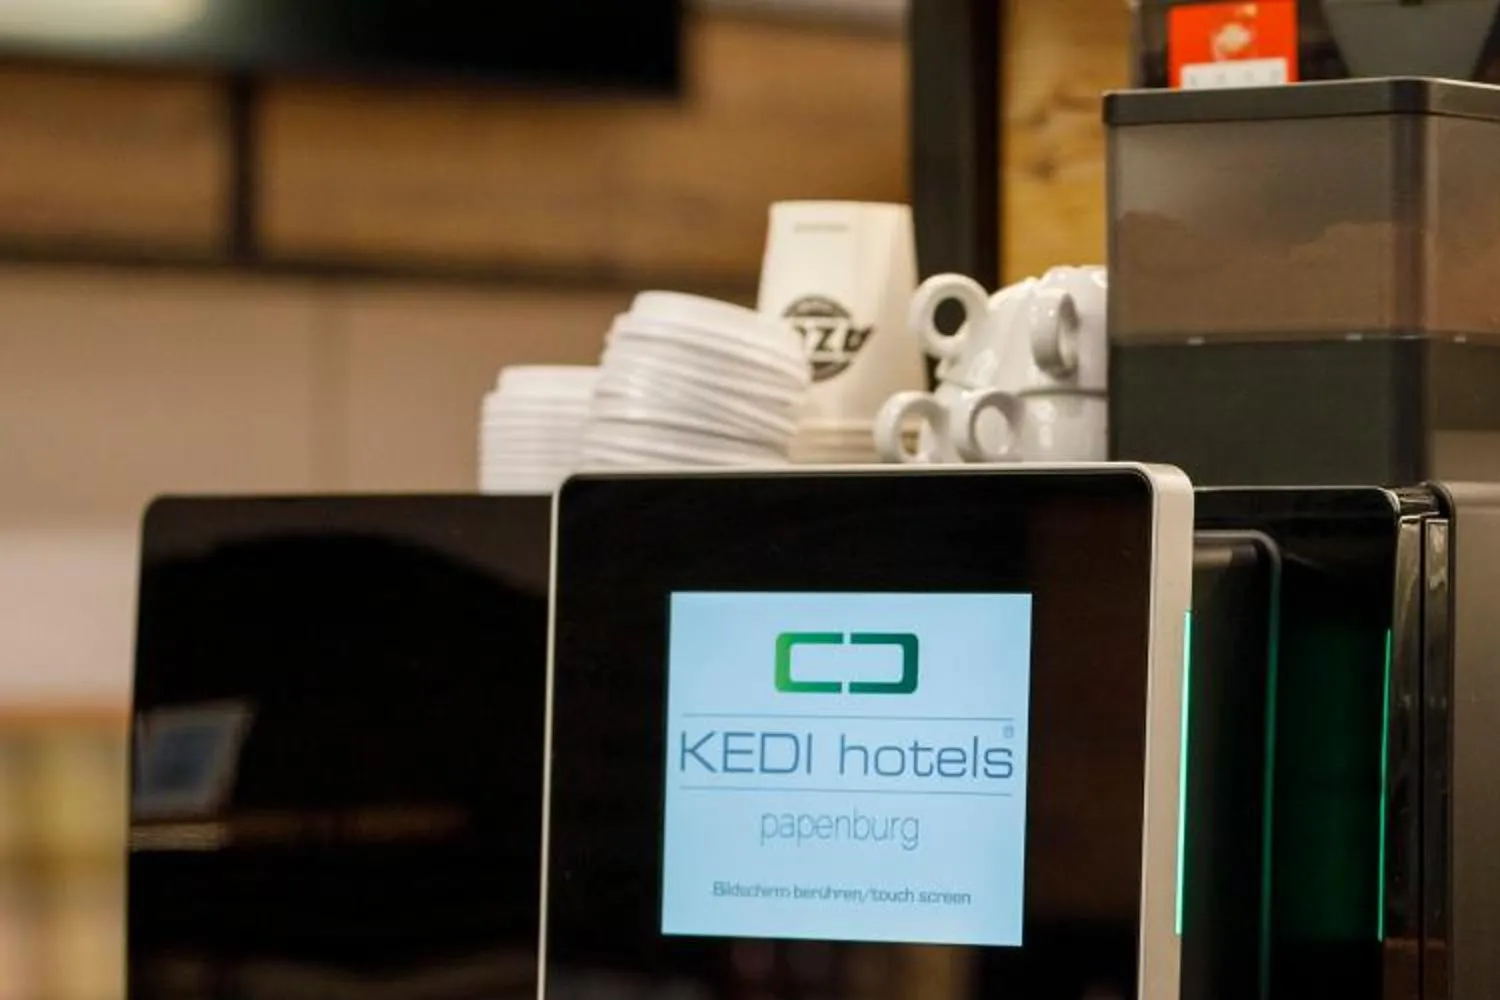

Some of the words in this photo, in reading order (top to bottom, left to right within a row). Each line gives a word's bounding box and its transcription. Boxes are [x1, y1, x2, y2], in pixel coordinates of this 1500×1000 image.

[680, 731, 813, 774] KEDI
[760, 806, 919, 851] papenburg
[712, 880, 791, 898] Bildschirm
[918, 889, 972, 906] screen
